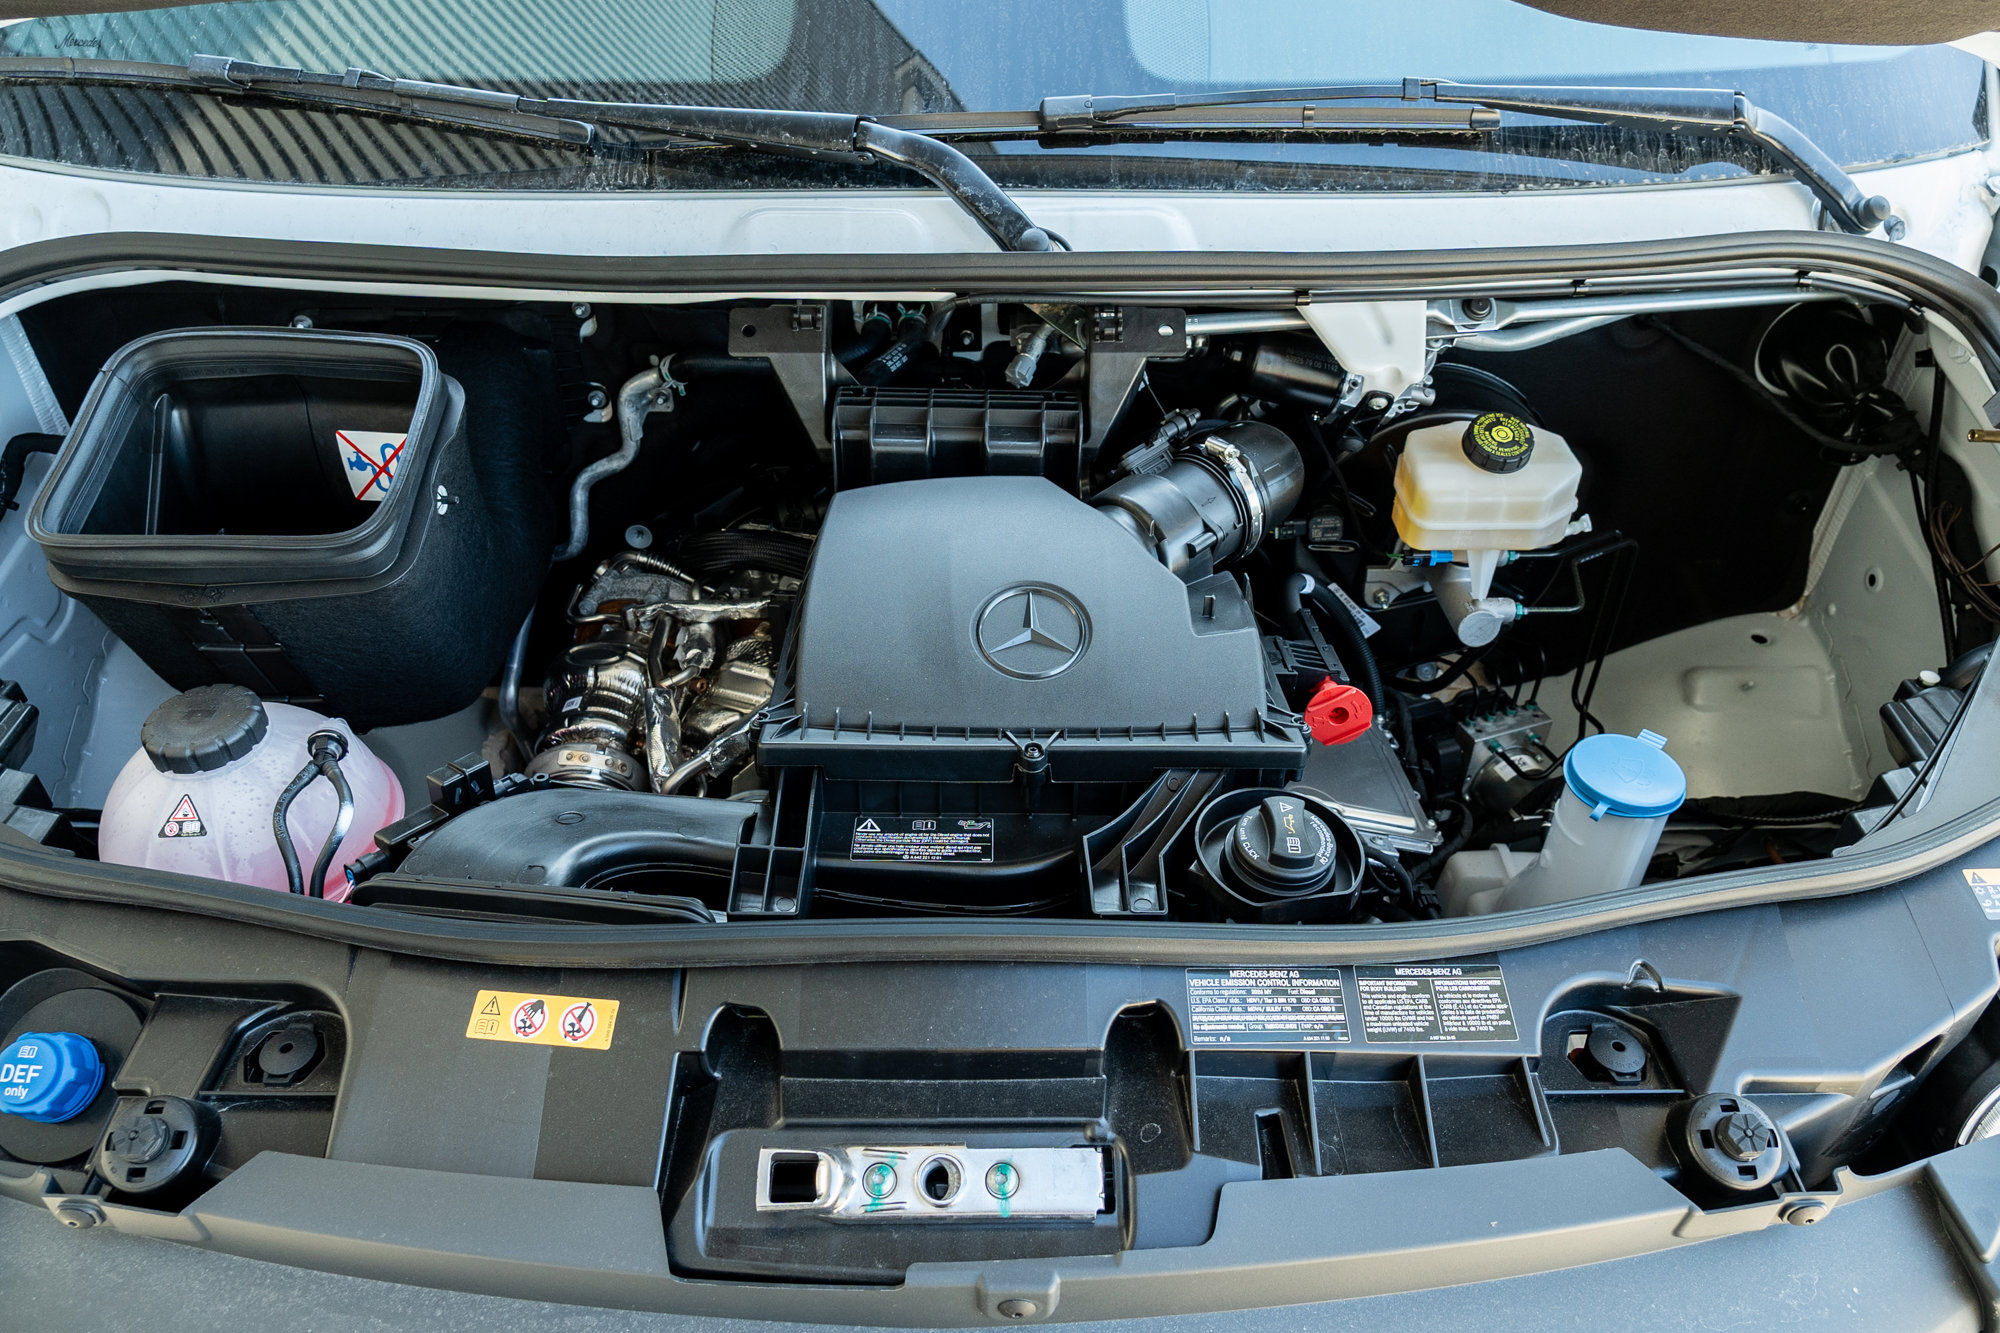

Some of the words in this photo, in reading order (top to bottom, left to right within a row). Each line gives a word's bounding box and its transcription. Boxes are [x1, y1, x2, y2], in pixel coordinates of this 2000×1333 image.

[1240, 815, 1252, 828] Turn
[1240, 828, 1248, 840] until
[1242, 842, 1260, 860] CLICK
[0, 1064, 42, 1084] DEF
[4, 1085, 28, 1099] only
